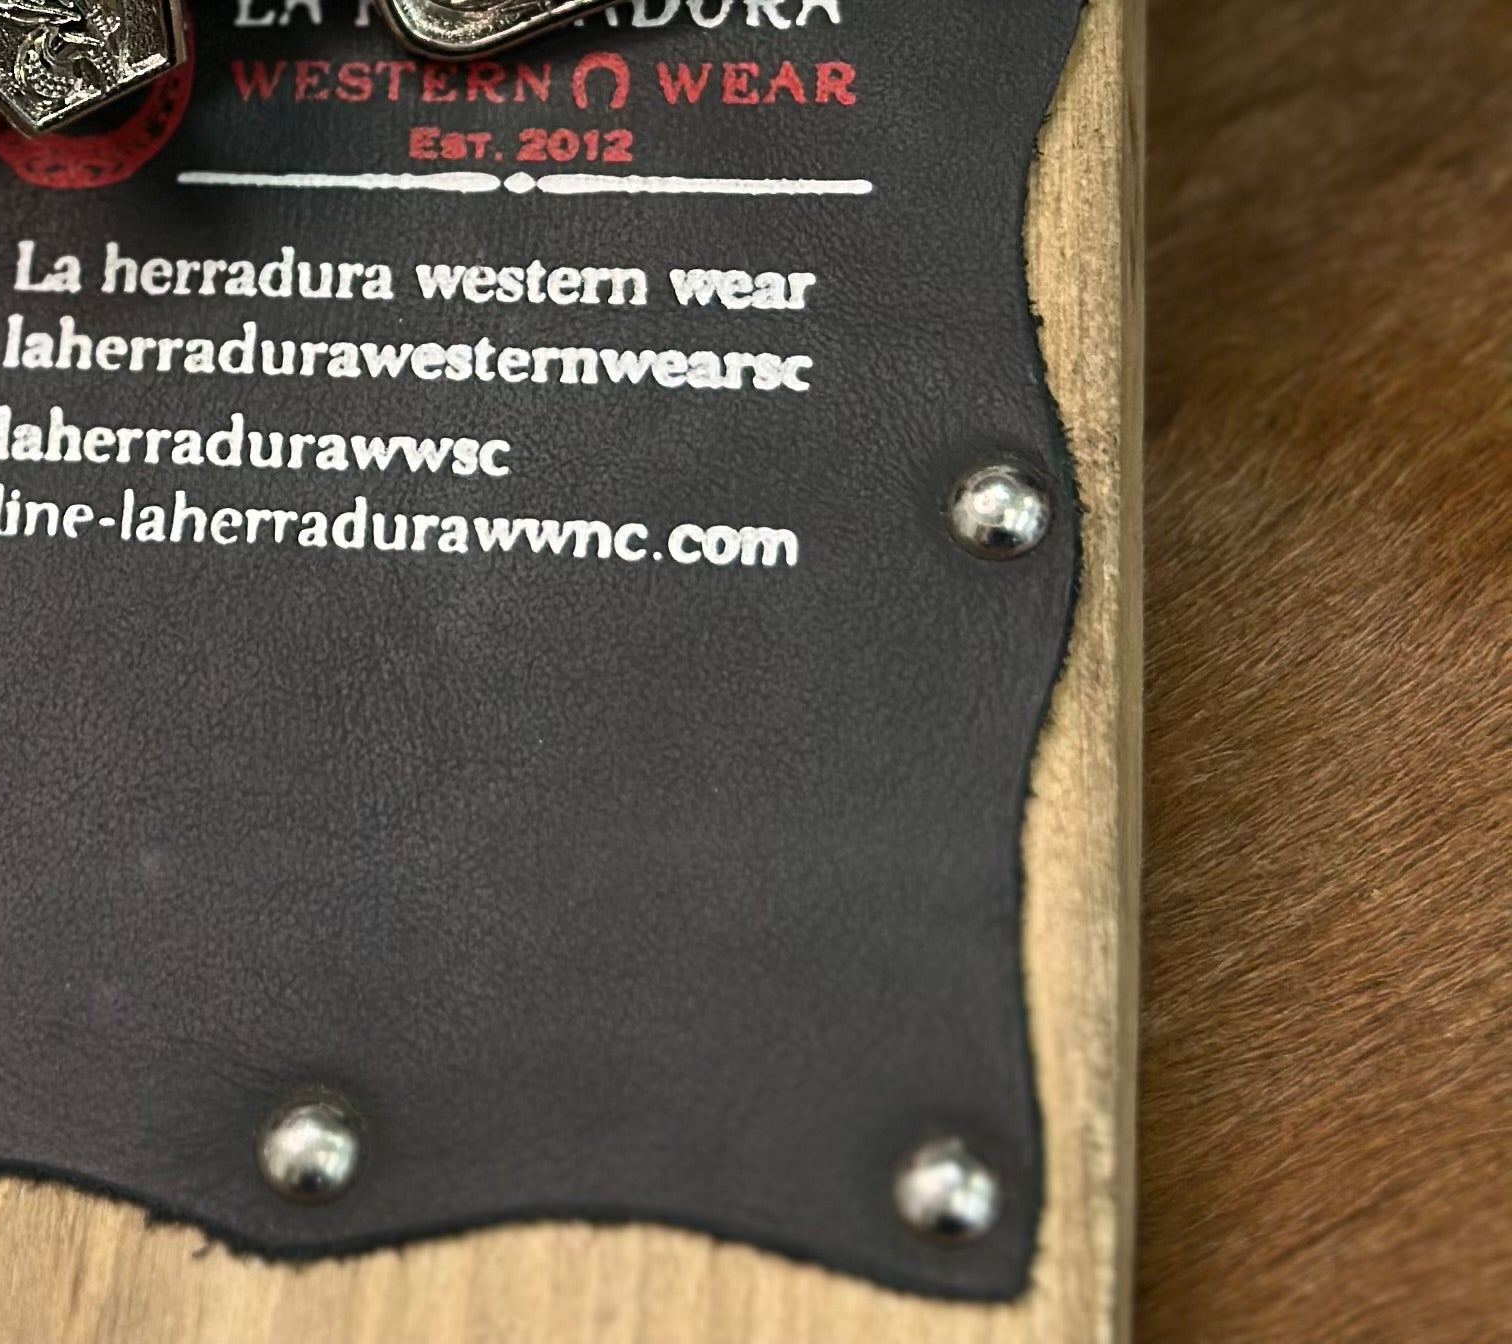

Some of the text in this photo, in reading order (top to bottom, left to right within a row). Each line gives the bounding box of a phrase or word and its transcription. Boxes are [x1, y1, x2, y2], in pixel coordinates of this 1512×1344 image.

[229, 61, 858, 108] WESTERN WEAR
[516, 128, 634, 164] 2012
[13, 238, 83, 294] La
[101, 242, 395, 301] herradura
[415, 259, 649, 307] western
[668, 268, 818, 310] wear
[1, 313, 815, 392] laherradurawesternwearsc
